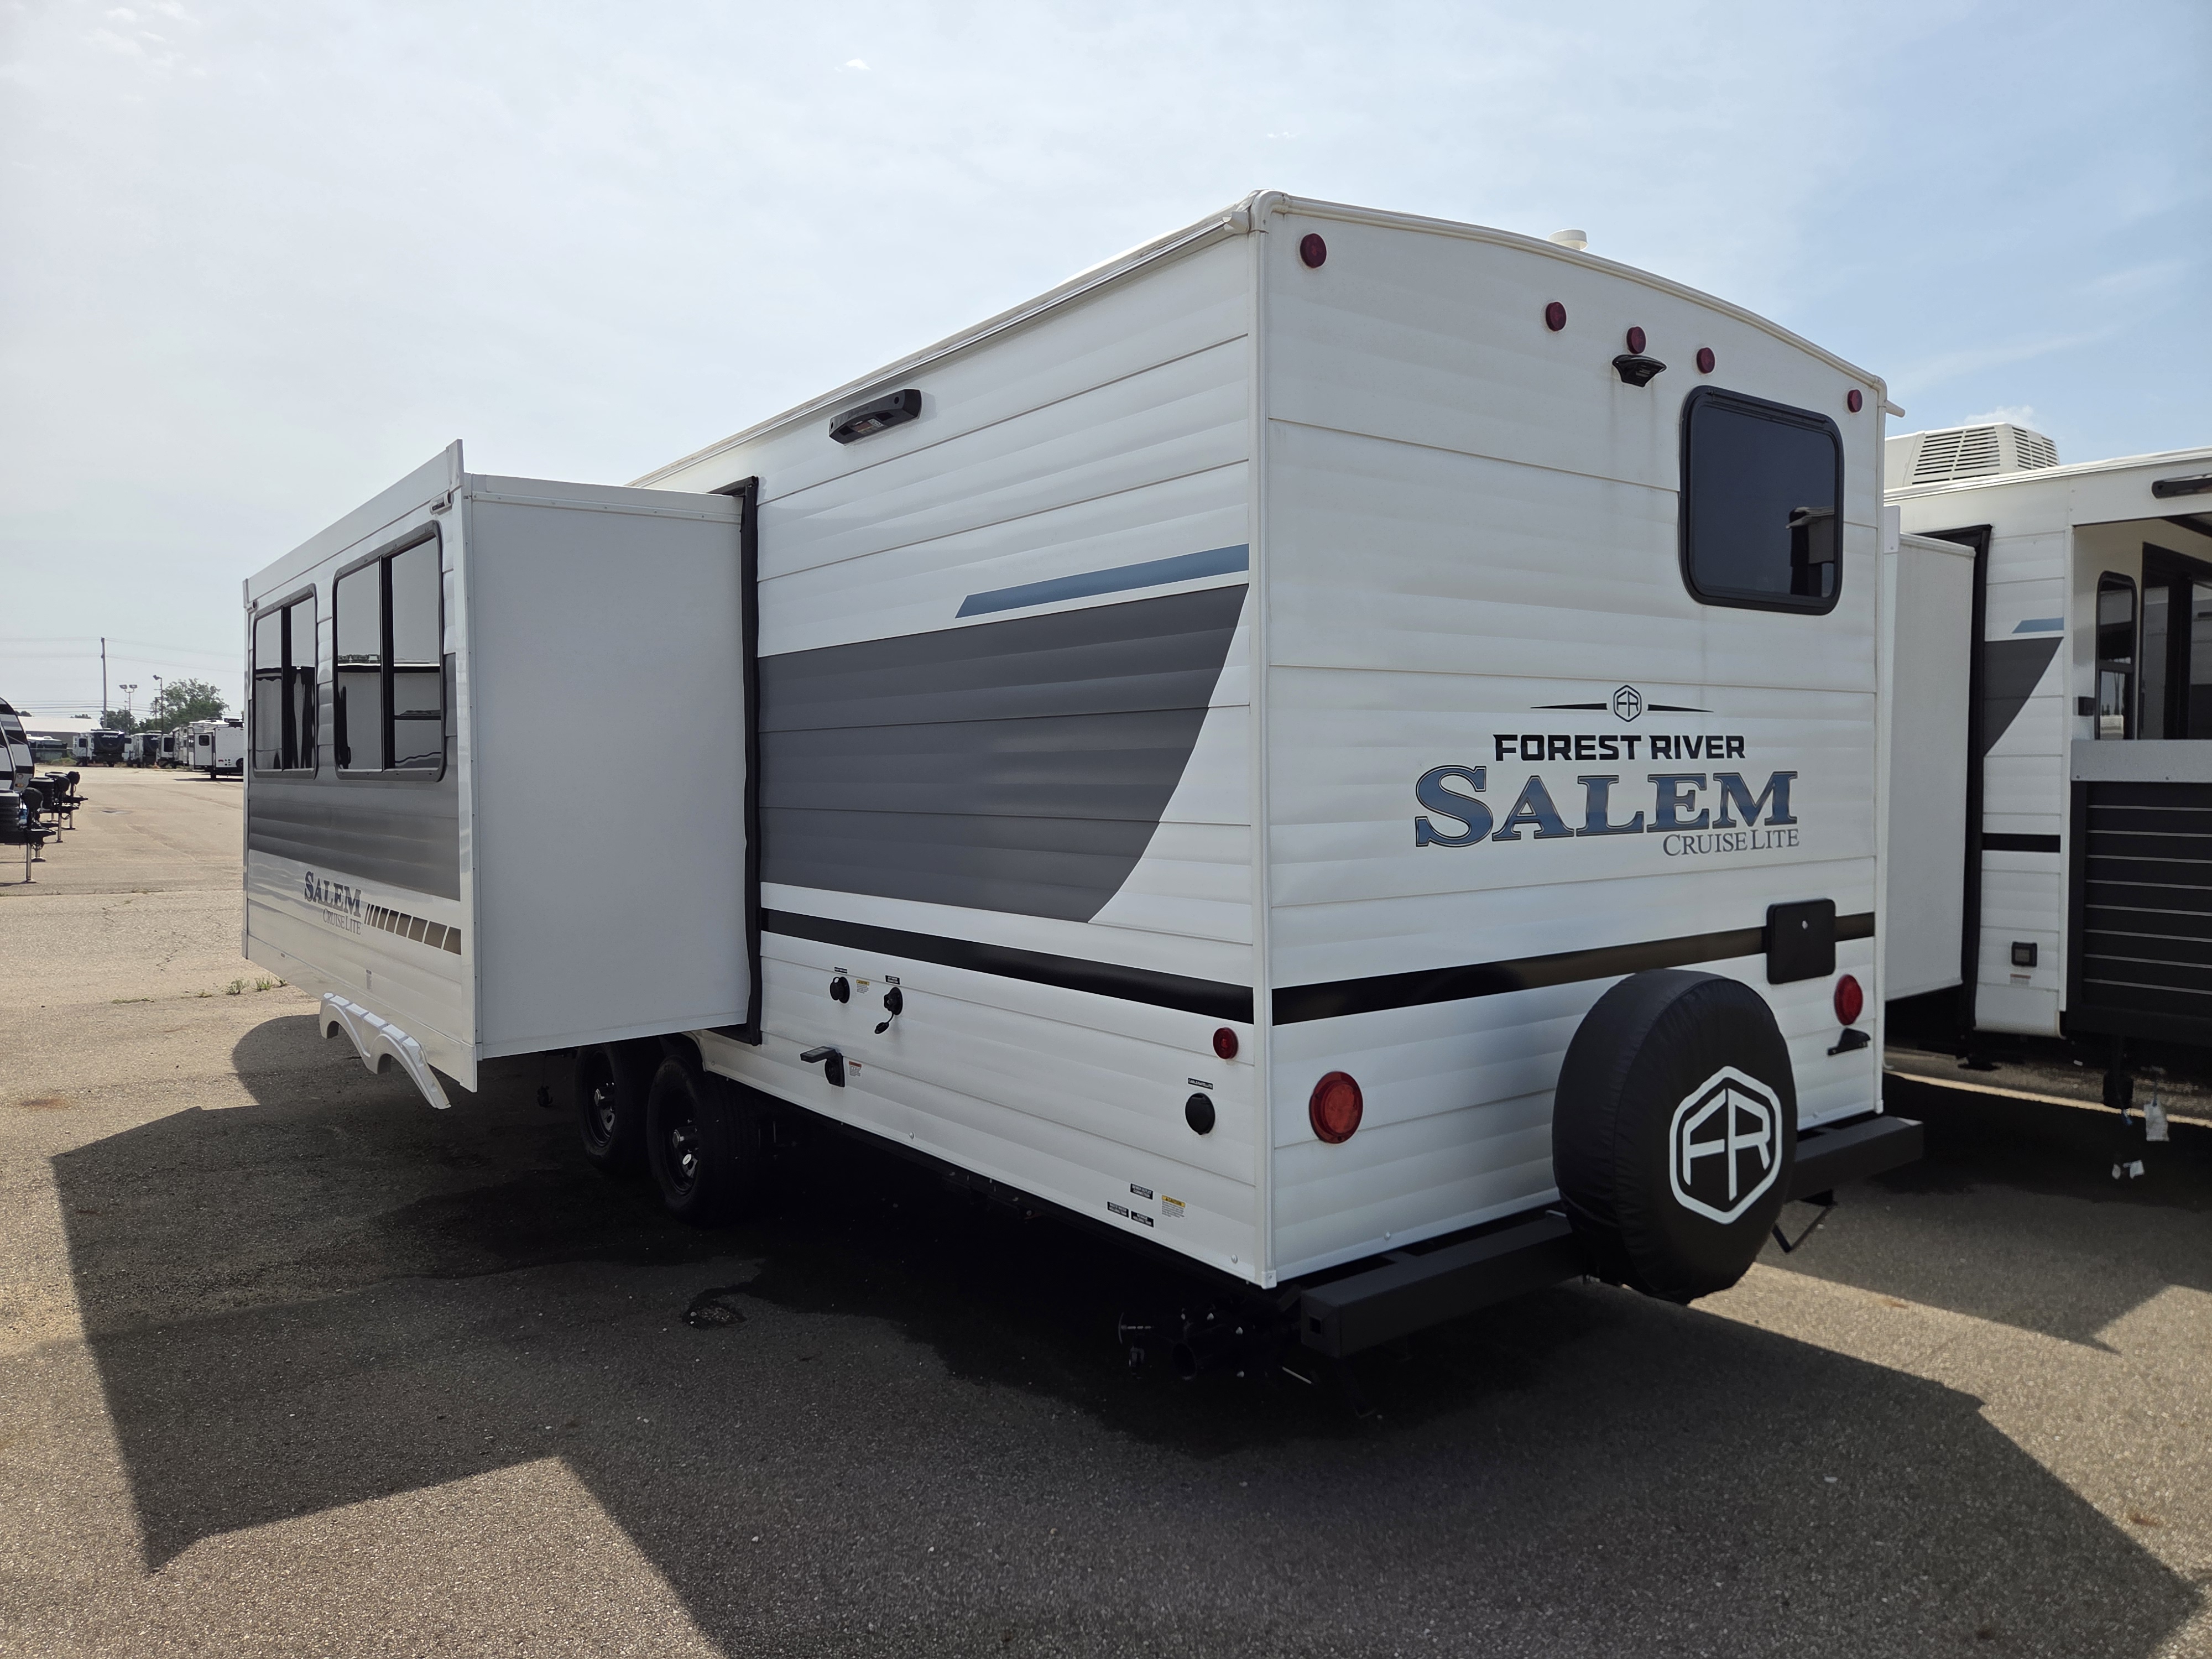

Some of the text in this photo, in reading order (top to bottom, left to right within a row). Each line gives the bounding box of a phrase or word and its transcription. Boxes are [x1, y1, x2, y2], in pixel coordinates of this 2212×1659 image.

[1493, 734, 1746, 761] FOREST RIVER
[1415, 764, 1798, 848] SALEM
[304, 870, 362, 918] SALEM
